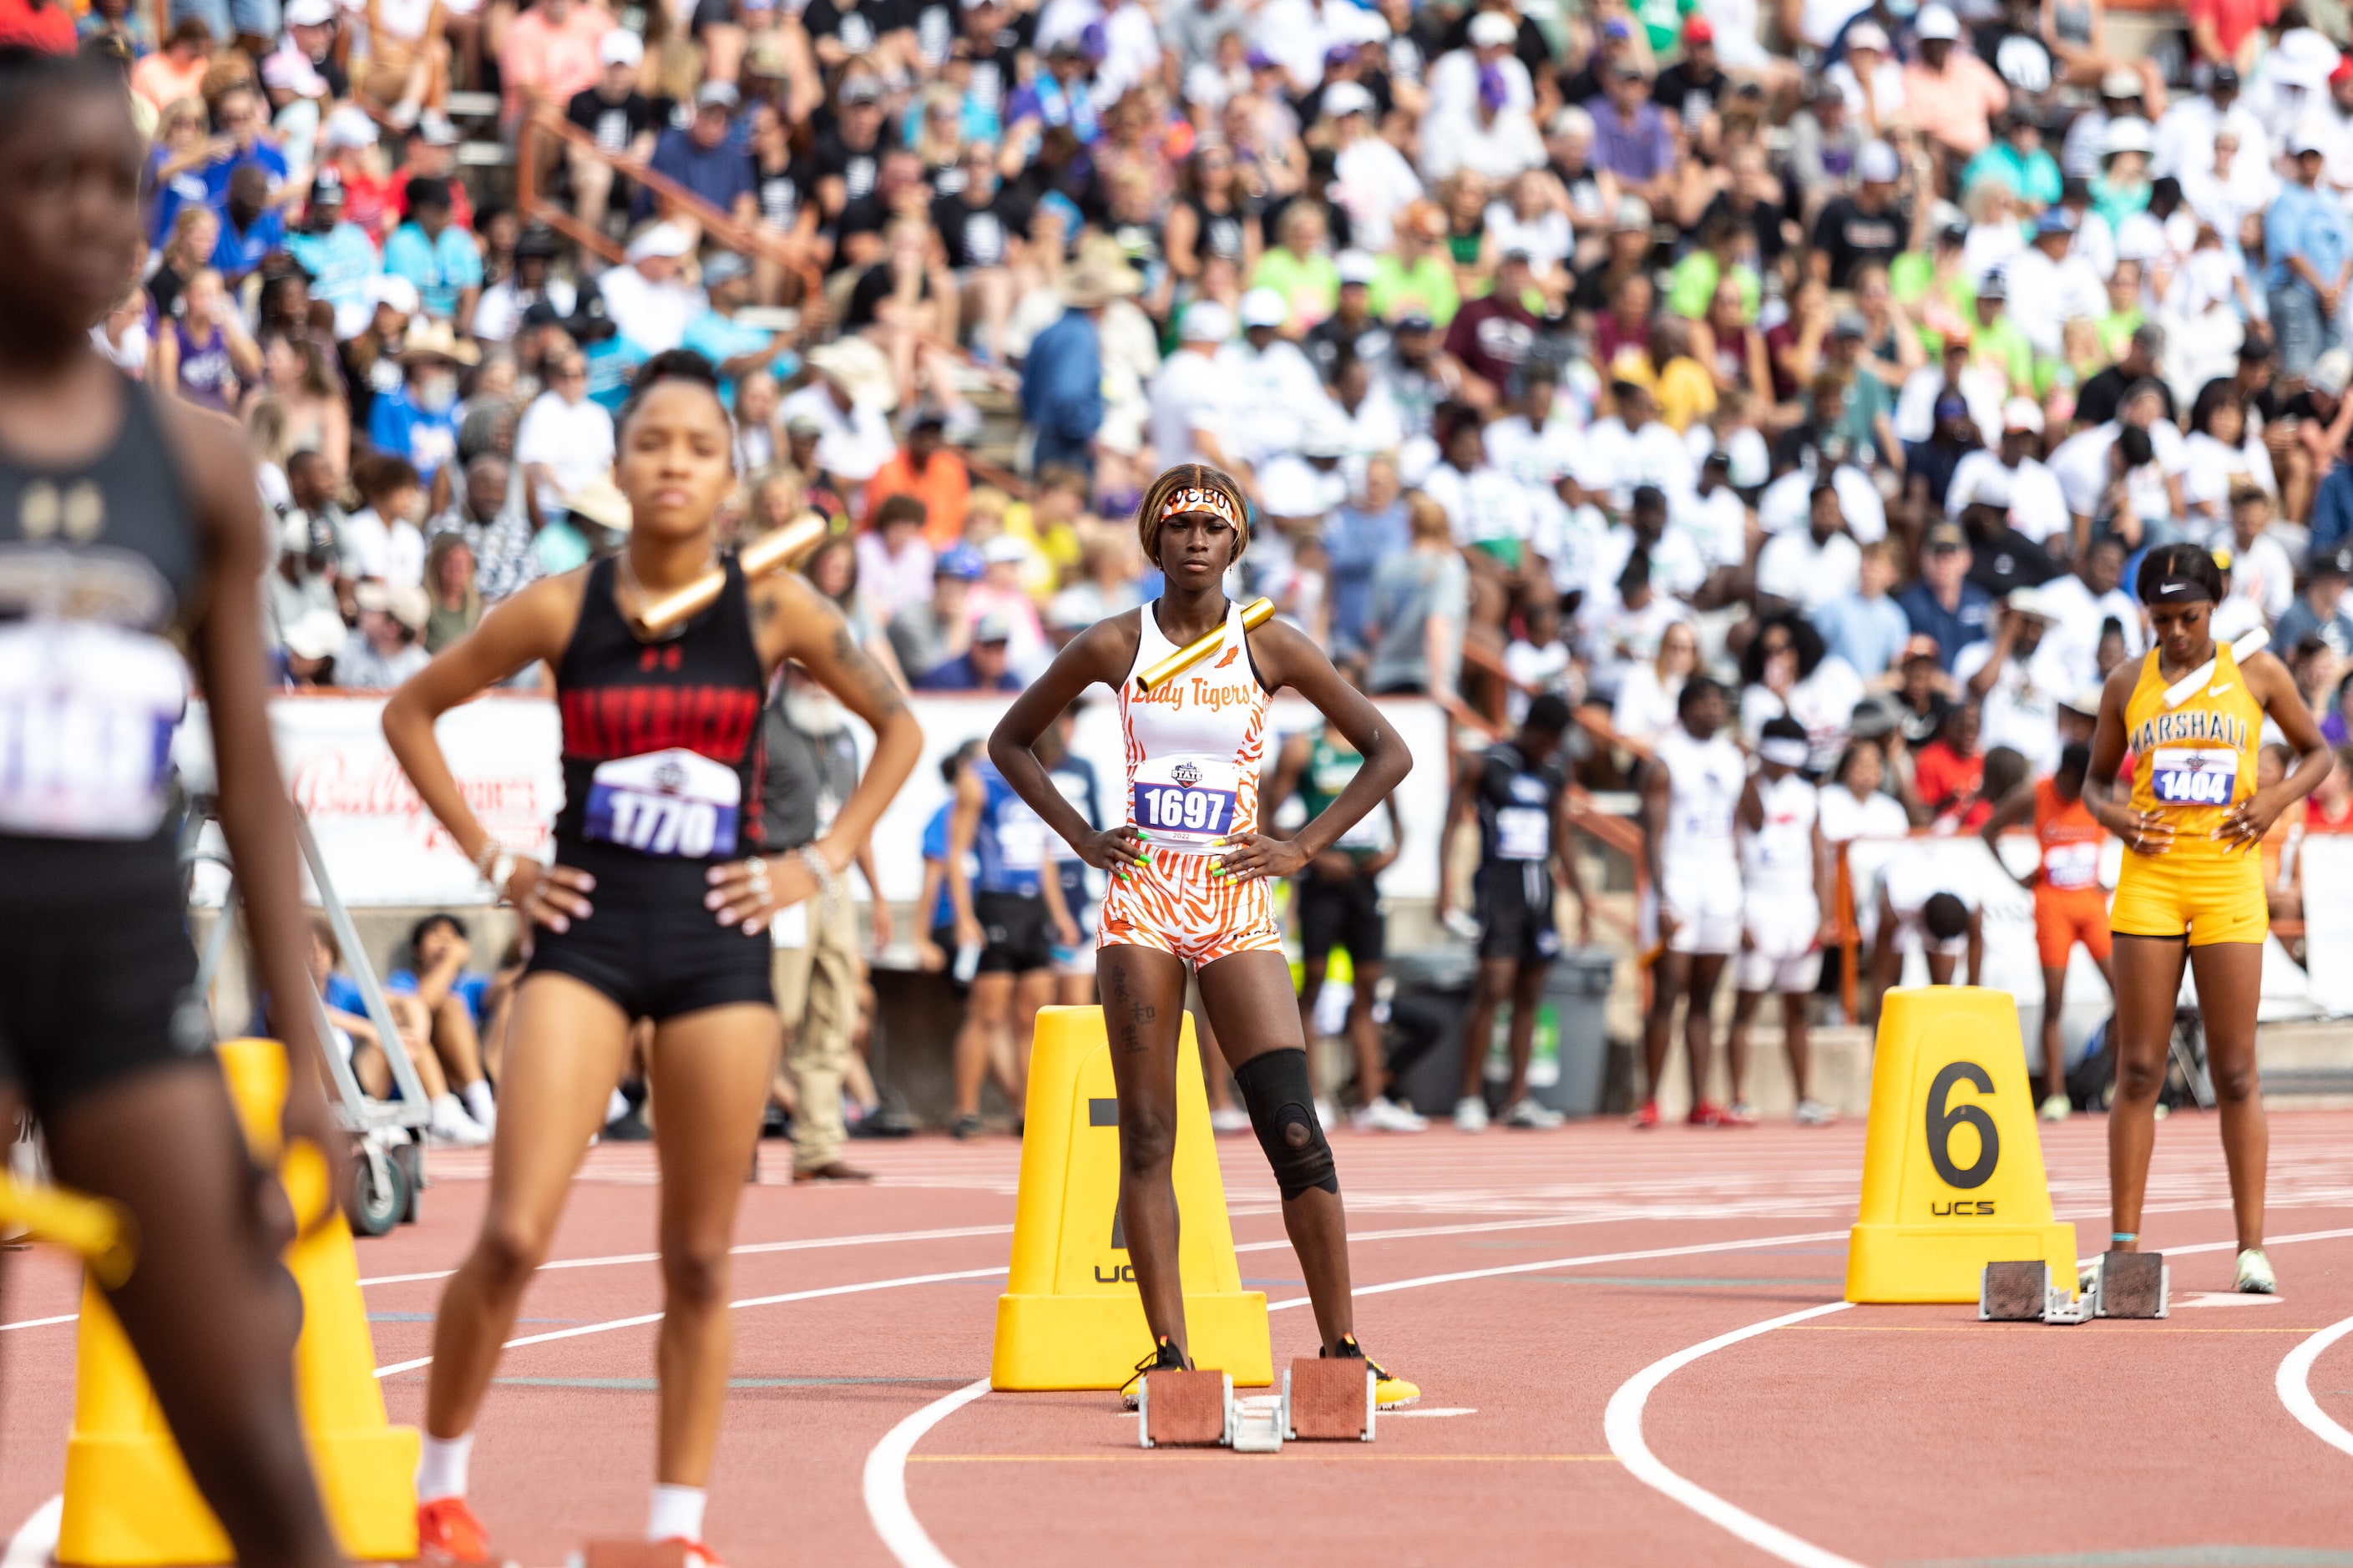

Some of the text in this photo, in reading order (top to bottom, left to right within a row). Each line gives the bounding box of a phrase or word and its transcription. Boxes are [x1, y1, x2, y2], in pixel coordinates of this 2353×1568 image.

[1192, 678, 1250, 712] Tigers
[2130, 712, 2245, 754] MARSHALL
[2161, 771, 2226, 804] 1404
[609, 791, 718, 859] 1770
[1145, 788, 1225, 830] 1697
[1925, 1061, 2000, 1189] 6
[1931, 1201, 1995, 1215] UCS
